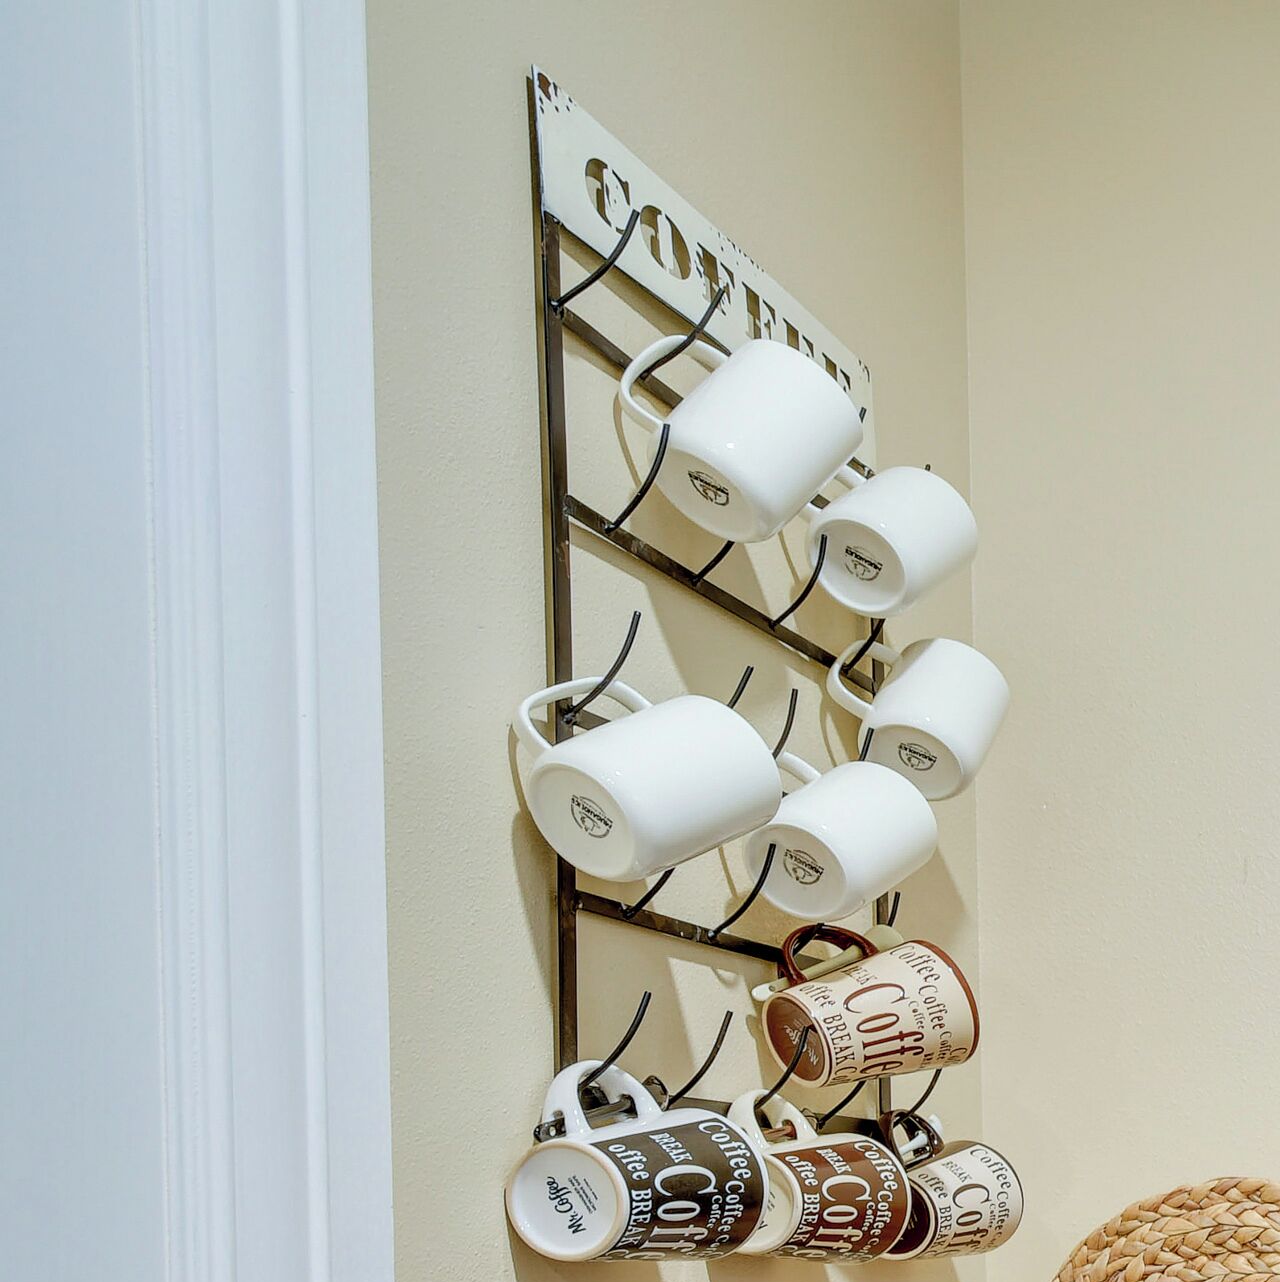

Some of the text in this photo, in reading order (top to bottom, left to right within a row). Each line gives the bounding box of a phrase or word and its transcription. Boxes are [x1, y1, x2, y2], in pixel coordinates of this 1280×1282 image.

[889, 945, 941, 984] Coffee
[918, 984, 949, 1031] Coffee
[823, 1013, 855, 1067] BREAK
[842, 982, 925, 1076] Coffe
[907, 1000, 925, 1031] Coffee
[649, 1132, 693, 1164] BREAK
[699, 1121, 752, 1181] Coffee
[969, 1148, 1012, 1190] Coffee
[546, 1176, 573, 1214] Coffee
[710, 1194, 723, 1229] Coffee
[713, 1180, 746, 1233] Coffee
[853, 1141, 898, 1236] Coffee Coffee
[613, 1188, 653, 1247] BREAK
[789, 1192, 820, 1243] BREAK
[861, 1202, 876, 1232] Coffee
[930, 1205, 953, 1249] BREAK
